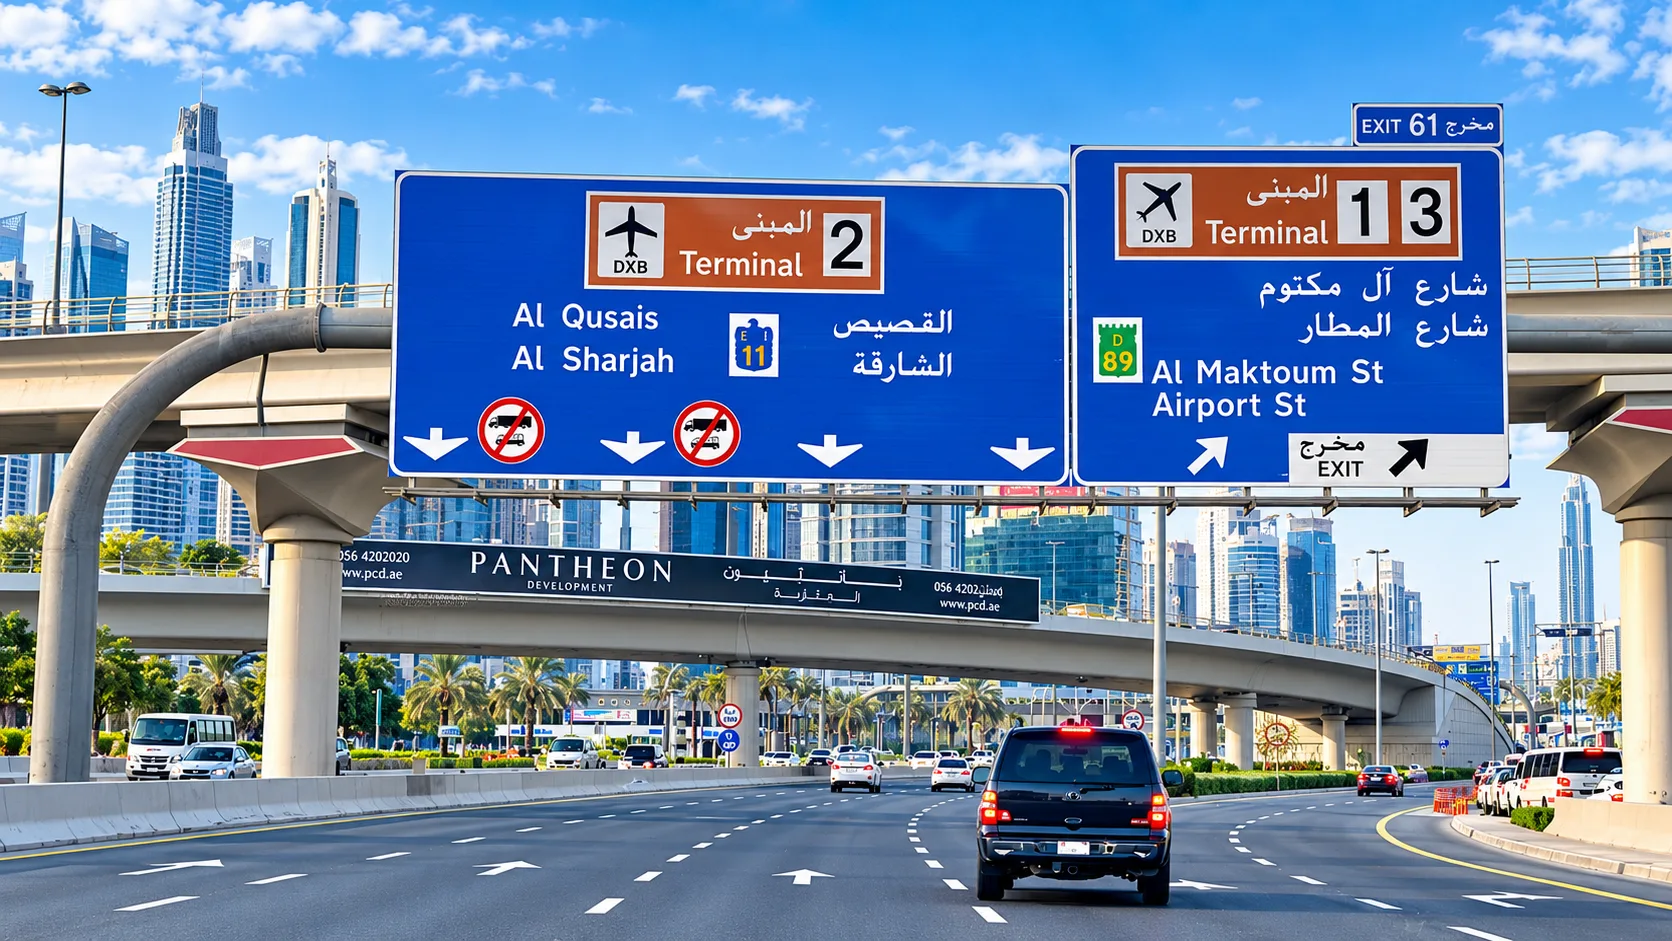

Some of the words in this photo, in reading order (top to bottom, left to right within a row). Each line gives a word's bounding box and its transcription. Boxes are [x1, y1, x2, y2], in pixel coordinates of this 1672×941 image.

[1362, 119, 1402, 134] EXIT
[1409, 113, 1437, 137] 61
[1446, 117, 1494, 136] مخرج
[1247, 174, 1328, 206] المبنى
[732, 209, 812, 241] المبنى
[1351, 187, 1370, 237] 1
[1409, 187, 1443, 237] 3
[830, 219, 864, 270] 2
[1142, 229, 1177, 243] DXB
[1205, 220, 1329, 245] Terminal
[613, 260, 648, 274] DXB
[679, 250, 803, 277] Terminal
[1259, 272, 1341, 308] مكتوم
[1362, 267, 1394, 302] آل
[1415, 272, 1488, 306] شارع
[512, 302, 545, 328] Al
[562, 303, 659, 330] Qusais
[833, 309, 953, 339] القصيص
[1298, 311, 1391, 344] المطار
[1112, 334, 1123, 347] D
[1415, 313, 1488, 347] شارع
[511, 345, 545, 371] Al
[562, 346, 674, 378] Sharjah
[742, 345, 765, 367] 11
[852, 351, 952, 382] الشارقة
[1103, 351, 1133, 372] 89
[1152, 360, 1183, 385] Al
[1197, 359, 1336, 385] Maktoum
[1351, 358, 1384, 384] St
[1152, 392, 1261, 422] Airport
[1274, 391, 1306, 417] St
[1300, 436, 1365, 459] مخرج
[1318, 461, 1364, 477] EXIT
[361, 550, 410, 563] 4202020
[470, 551, 672, 583] PANTHEON
[526, 580, 614, 593] DEVELOPMENT
[934, 581, 953, 593] 056
[939, 599, 1000, 613] www.pcd.ae
